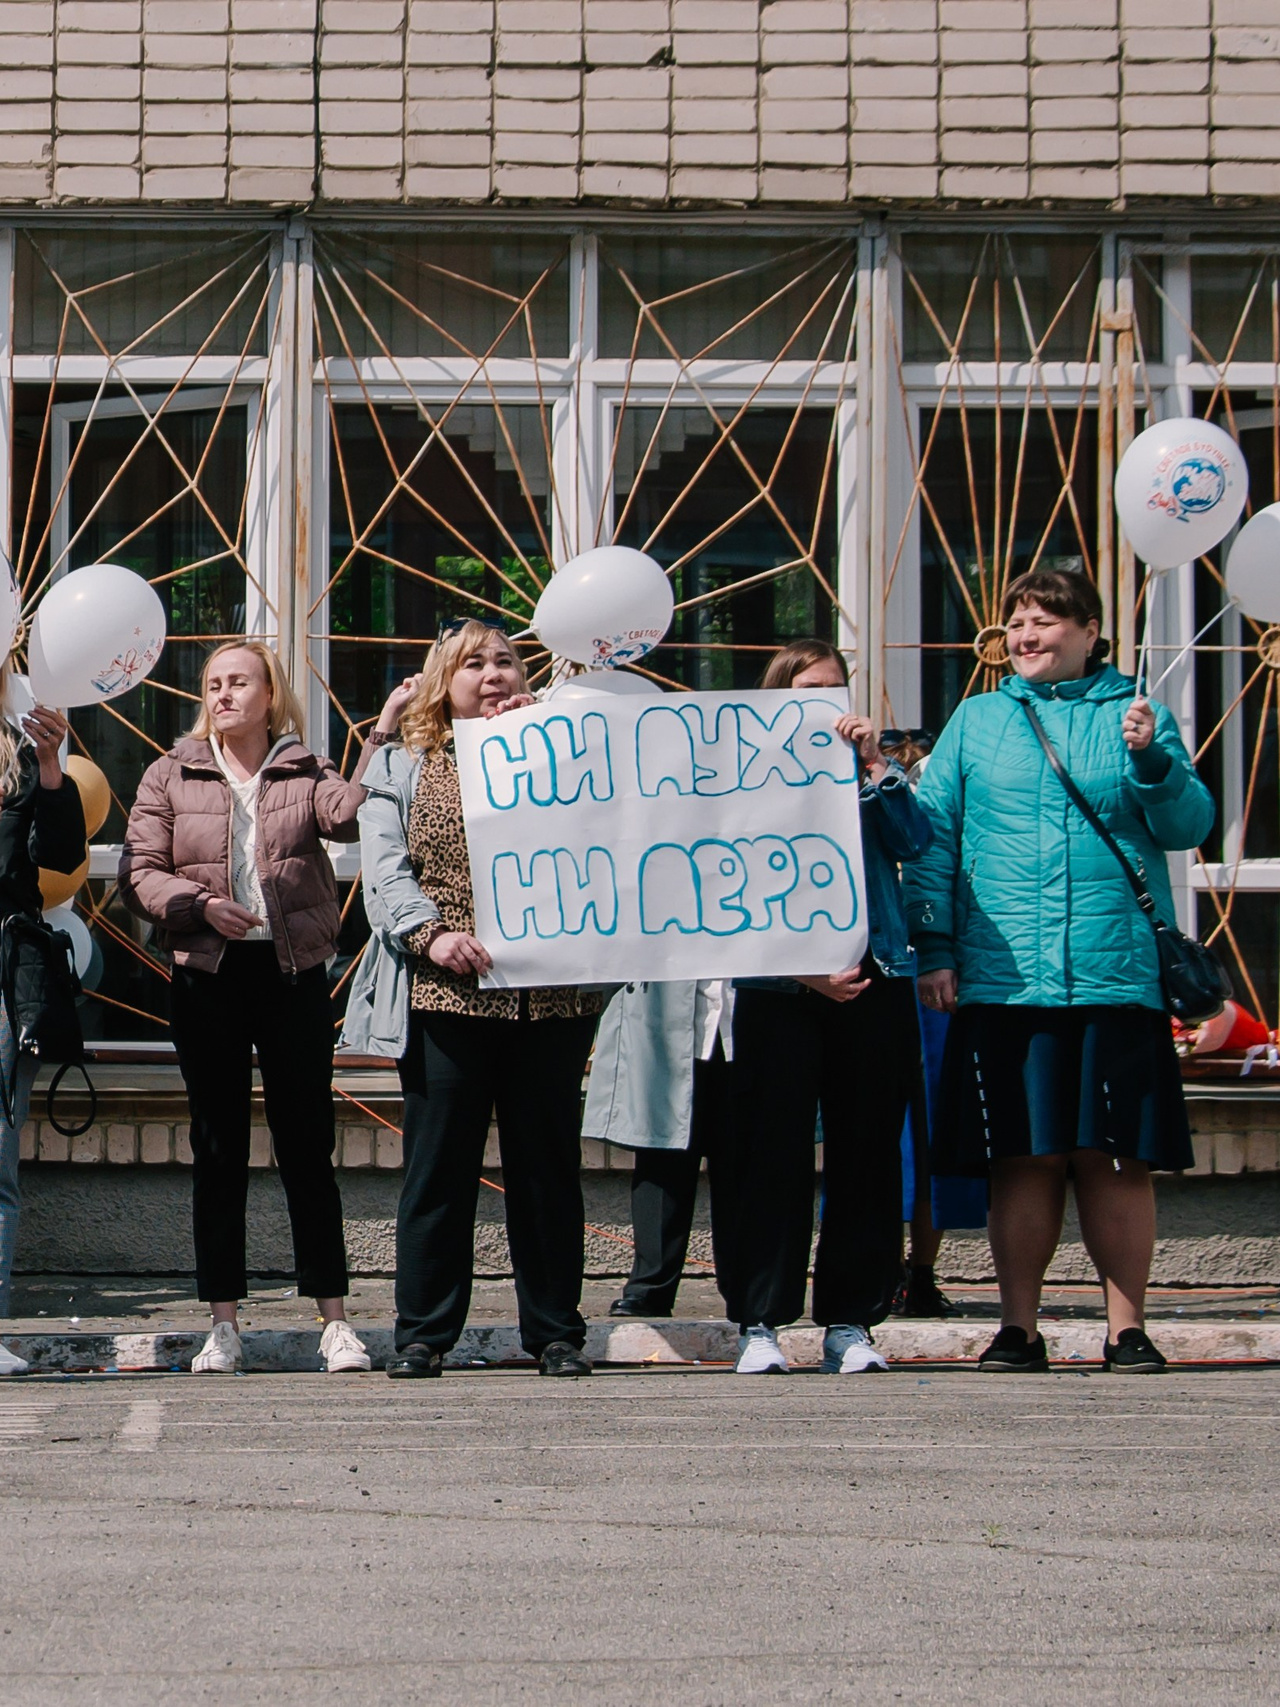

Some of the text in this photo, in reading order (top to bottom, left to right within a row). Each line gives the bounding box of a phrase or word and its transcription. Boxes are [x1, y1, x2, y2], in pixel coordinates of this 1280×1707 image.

[480, 699, 858, 810] НИ ПУХА
[491, 846, 619, 941] НИ
